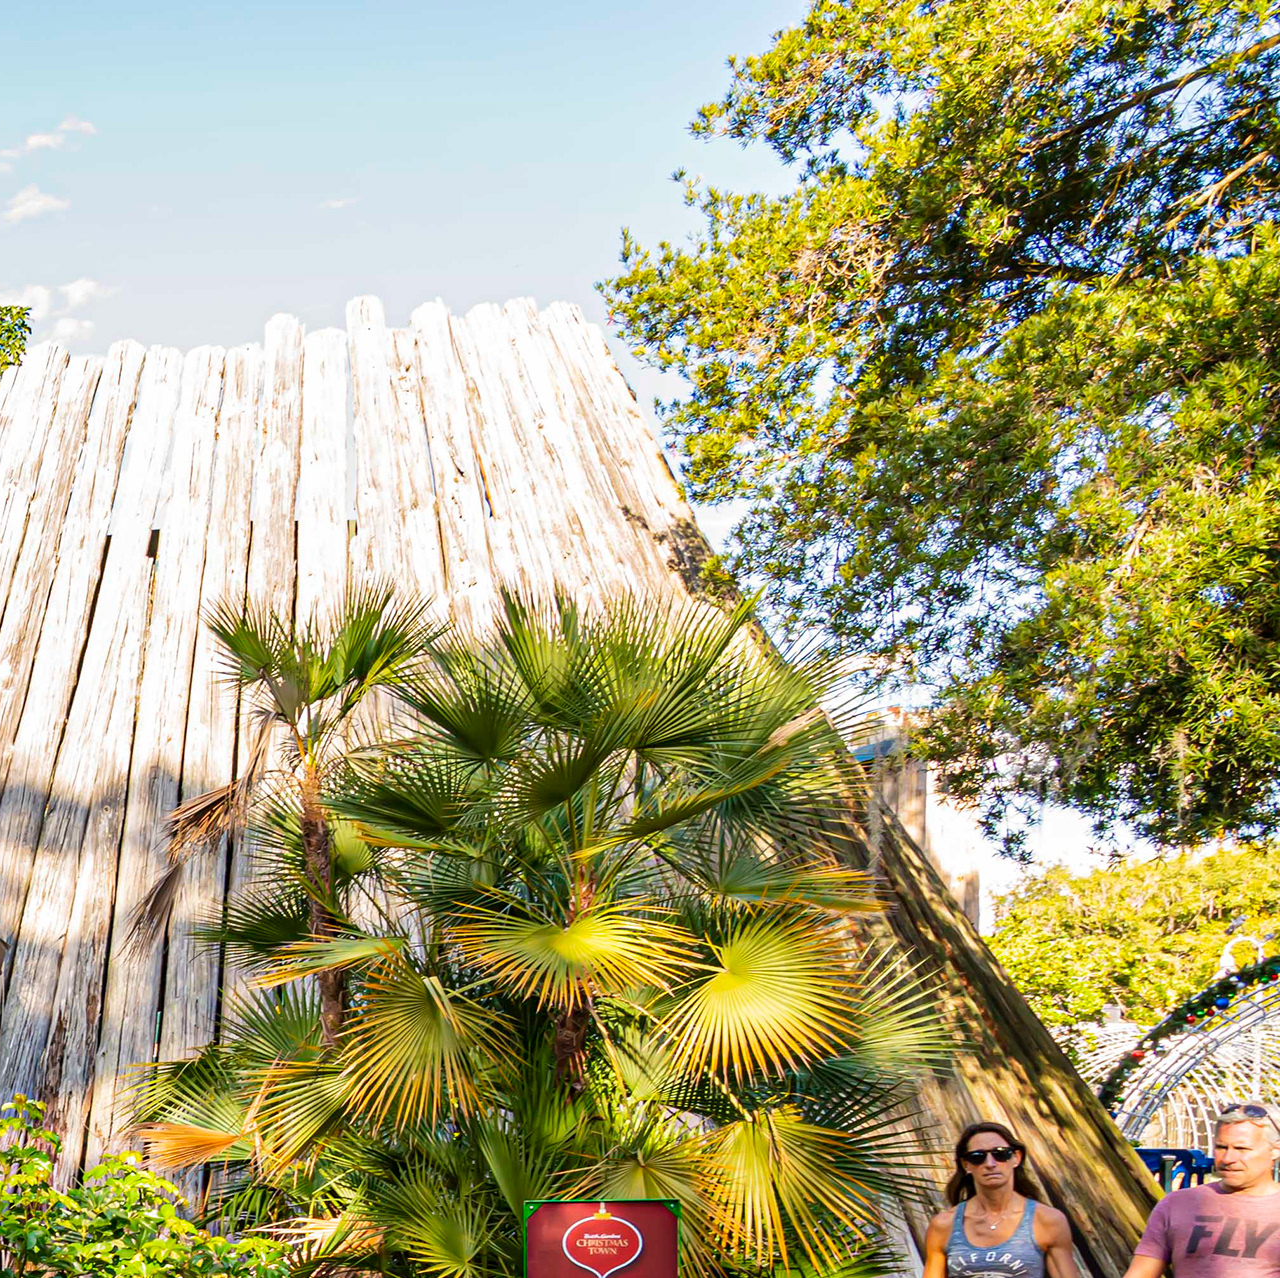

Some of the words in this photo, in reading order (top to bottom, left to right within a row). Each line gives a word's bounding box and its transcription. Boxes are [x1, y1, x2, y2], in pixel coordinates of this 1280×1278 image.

[1186, 1215, 1280, 1258] FLY
[576, 1239, 628, 1247] CHRISTMAS
[587, 1247, 617, 1255] TOWN
